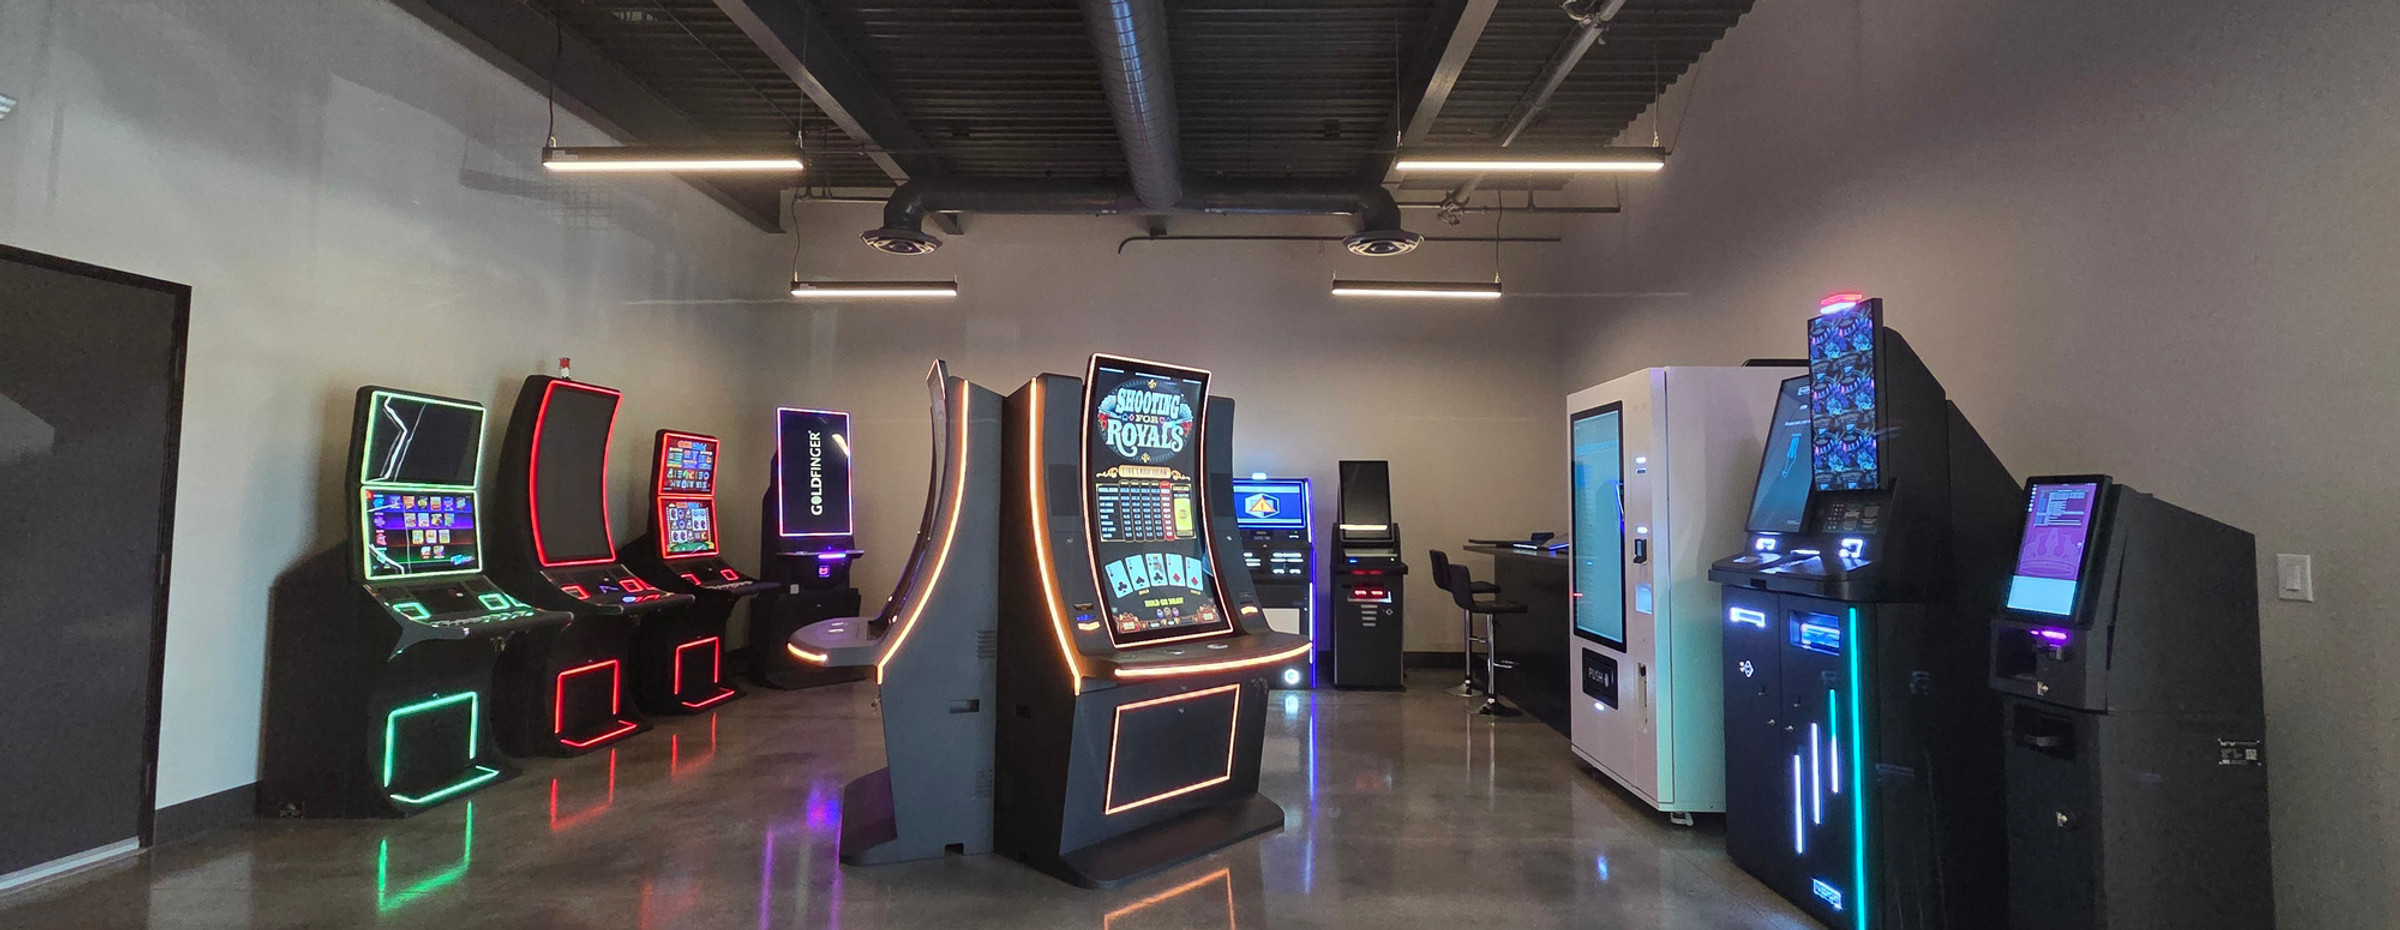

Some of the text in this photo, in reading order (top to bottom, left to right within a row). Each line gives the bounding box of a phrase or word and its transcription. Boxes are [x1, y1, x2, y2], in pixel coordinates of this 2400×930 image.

[1115, 388, 1181, 419] SHOOTING
[1135, 414, 1159, 423] FOR
[1105, 418, 1185, 457] ROYALS
[809, 431, 823, 516] GOLDFINGER
